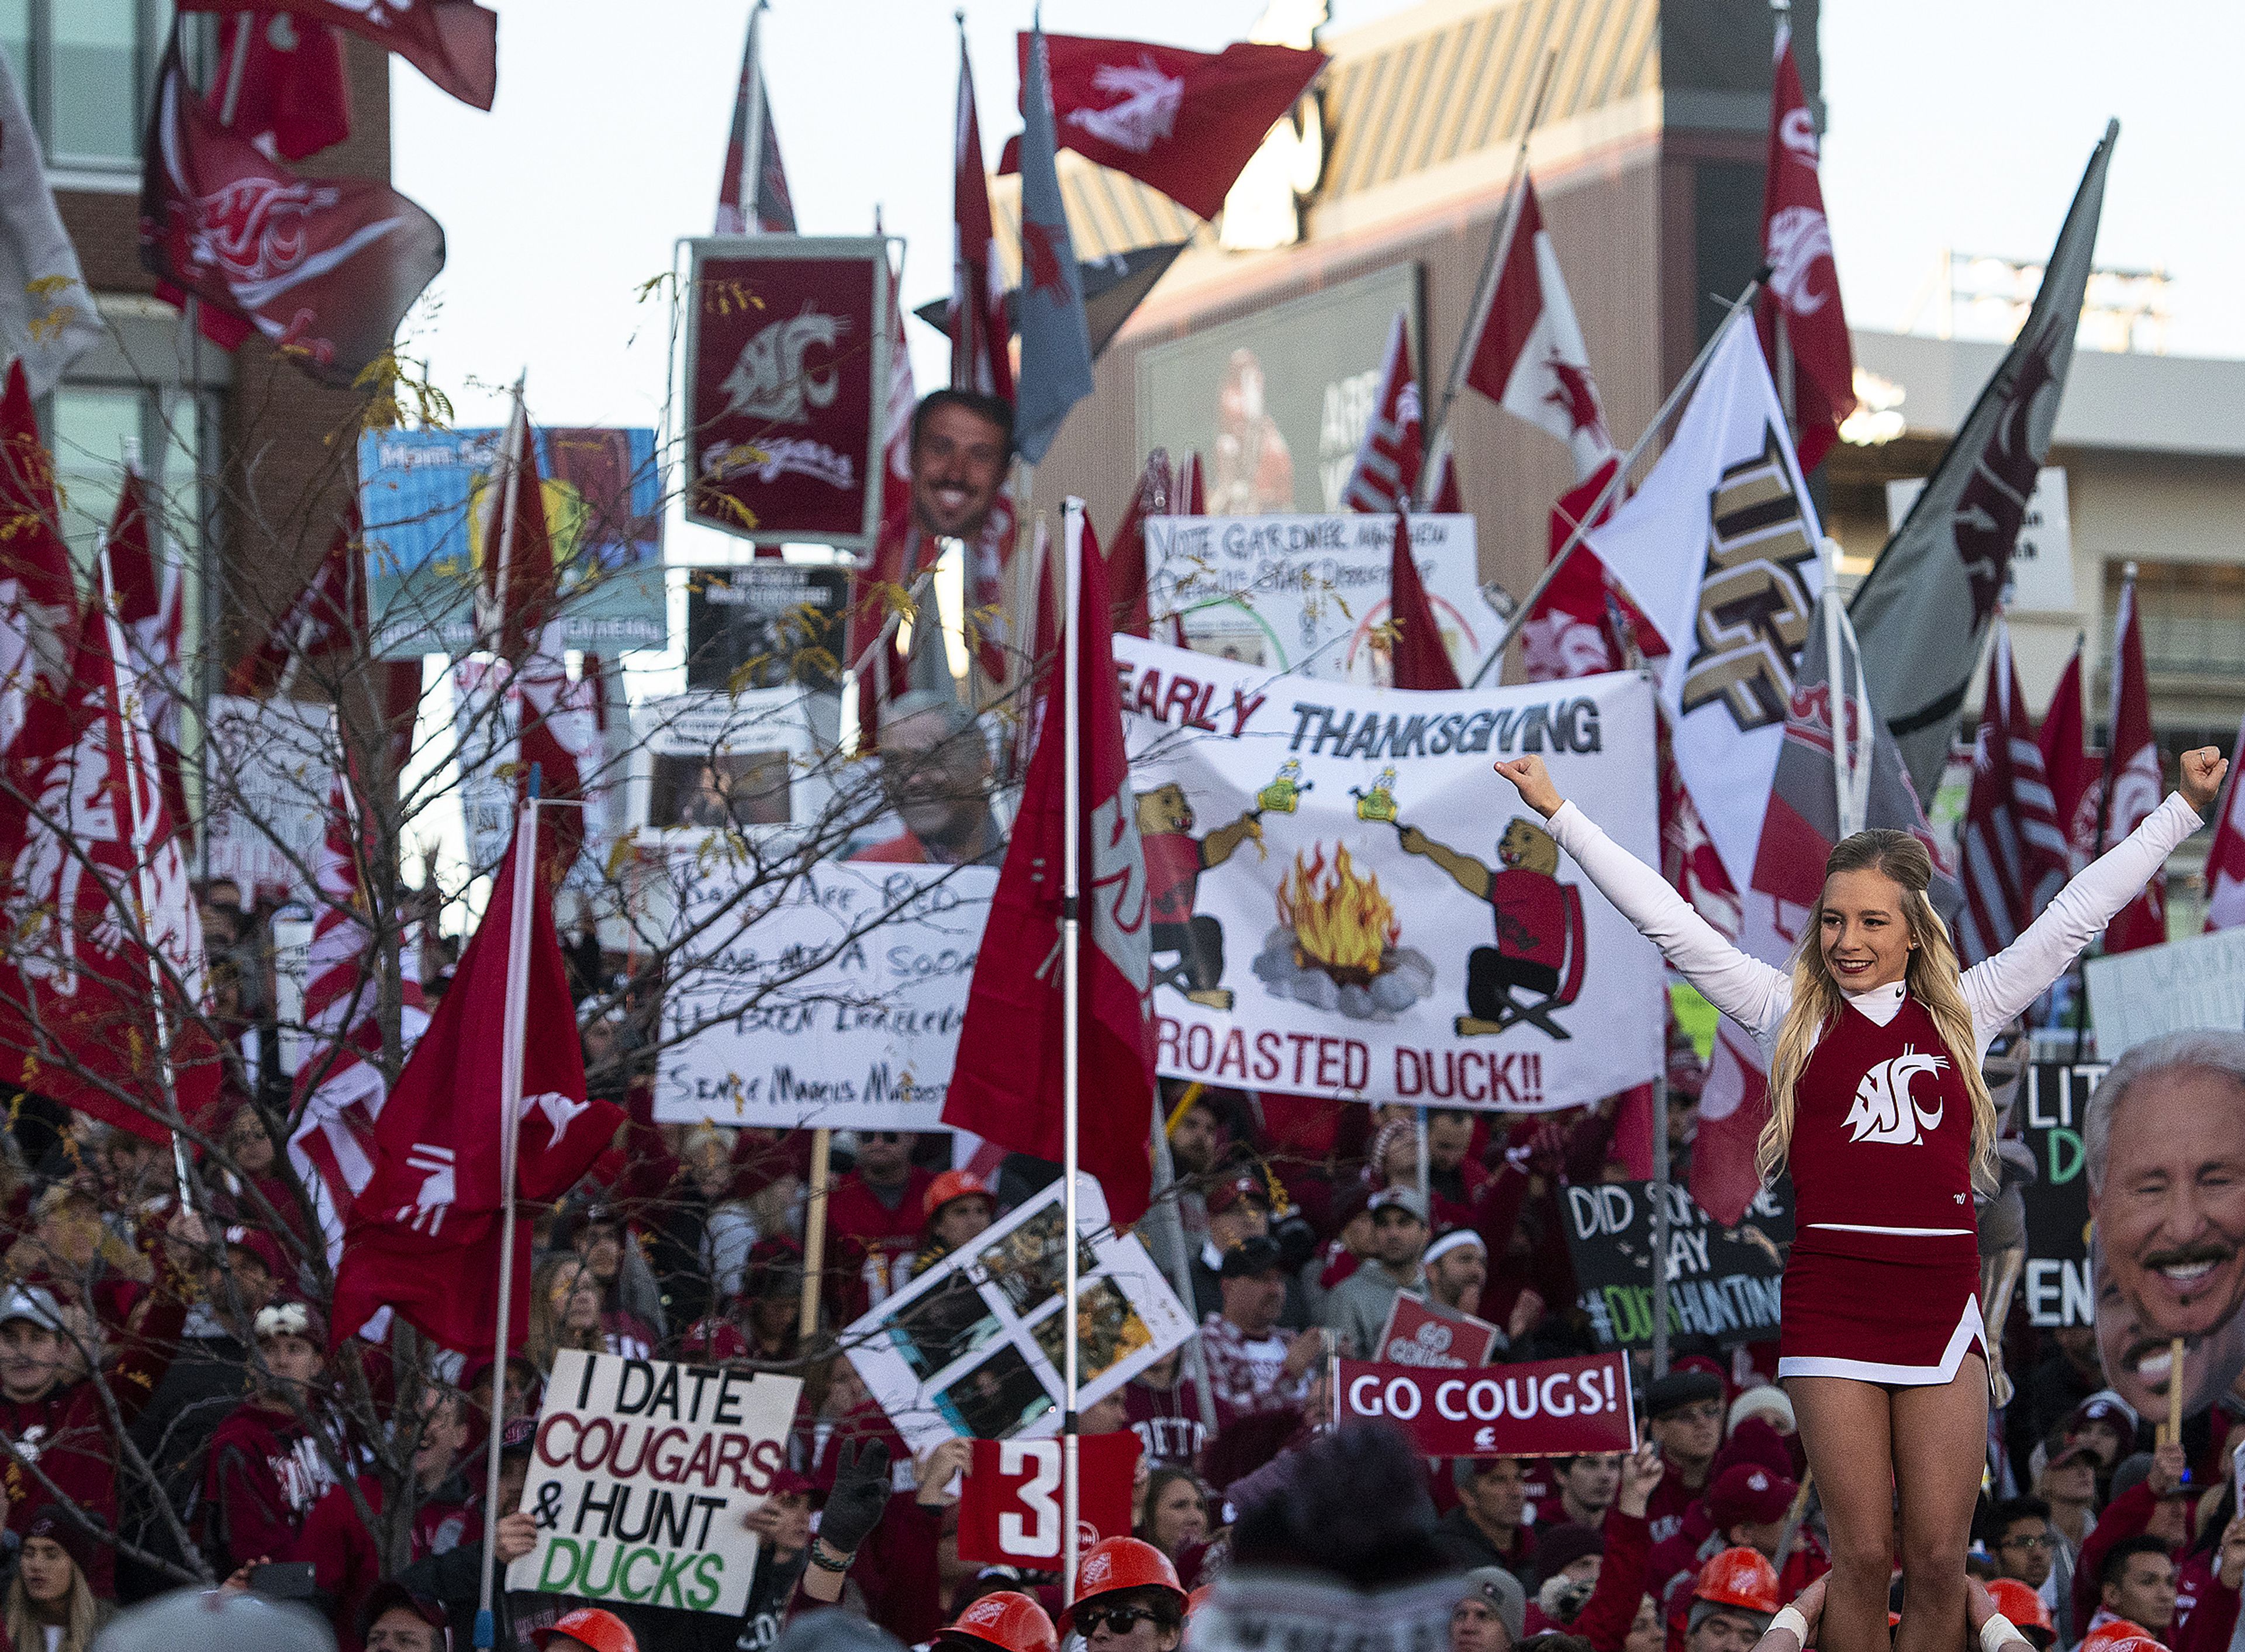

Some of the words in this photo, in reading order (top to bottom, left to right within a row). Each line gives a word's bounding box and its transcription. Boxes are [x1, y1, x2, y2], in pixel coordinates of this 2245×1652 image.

[1681, 418, 1819, 732] UCF
[1117, 666, 1266, 738] EARLY
[1289, 696, 1602, 760] THANKSGIVING
[1158, 1017, 1369, 1091] ROASTED
[1395, 1049, 1543, 1104] DUCK!!
[1567, 1185, 1635, 1240] DID
[576, 1355, 596, 1410] I
[614, 1360, 755, 1425] DATE
[1348, 1374, 1422, 1421] GO
[1434, 1365, 1618, 1422] COUGS!
[535, 1412, 787, 1495] COUGARS
[531, 1480, 564, 1530] &
[573, 1481, 728, 1550] HUNT
[999, 1439, 1063, 1558] 3
[536, 1537, 725, 1612] DUCKS
